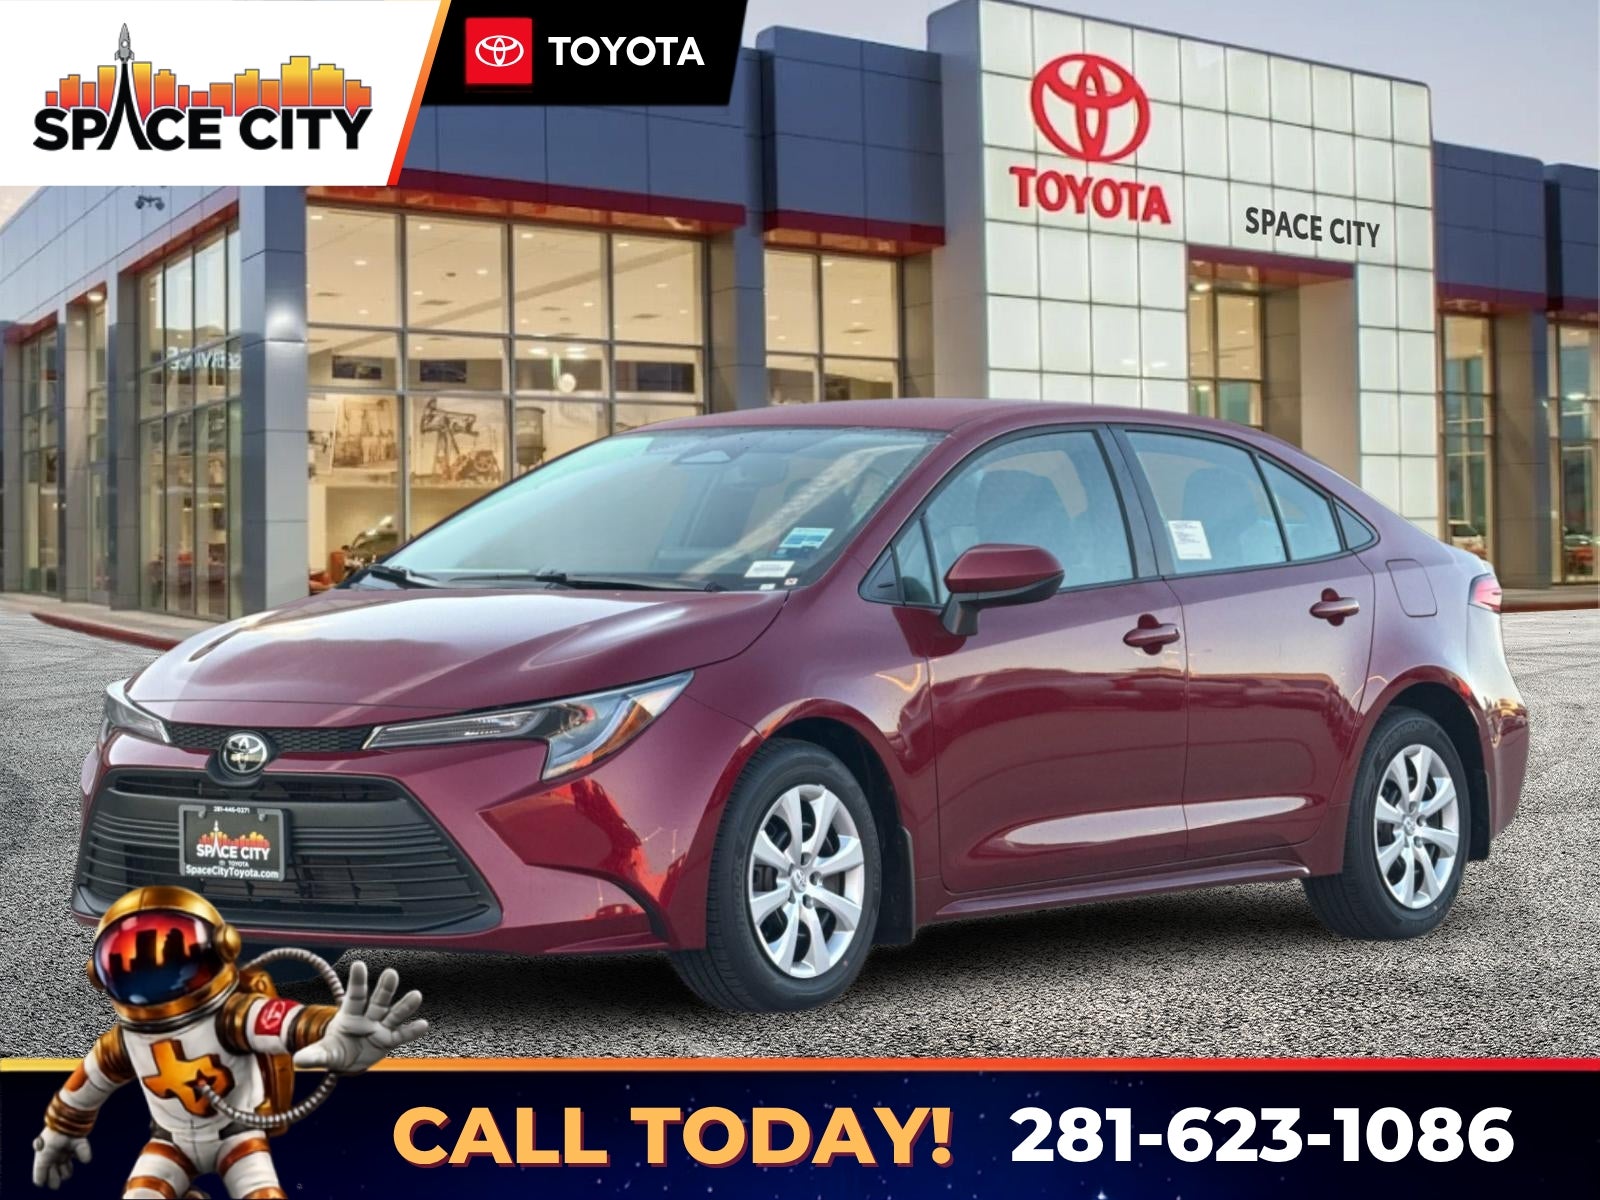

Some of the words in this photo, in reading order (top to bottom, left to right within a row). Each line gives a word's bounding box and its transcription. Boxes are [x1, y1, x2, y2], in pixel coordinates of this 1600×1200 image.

[1009, 166, 1172, 225] TOYOTA
[1245, 207, 1322, 242] SPACE
[1329, 218, 1380, 248] CITY
[196, 844, 238, 859] SPACE
[240, 847, 271, 860] CITY
[185, 864, 279, 879] SpaceCityToyota.com
